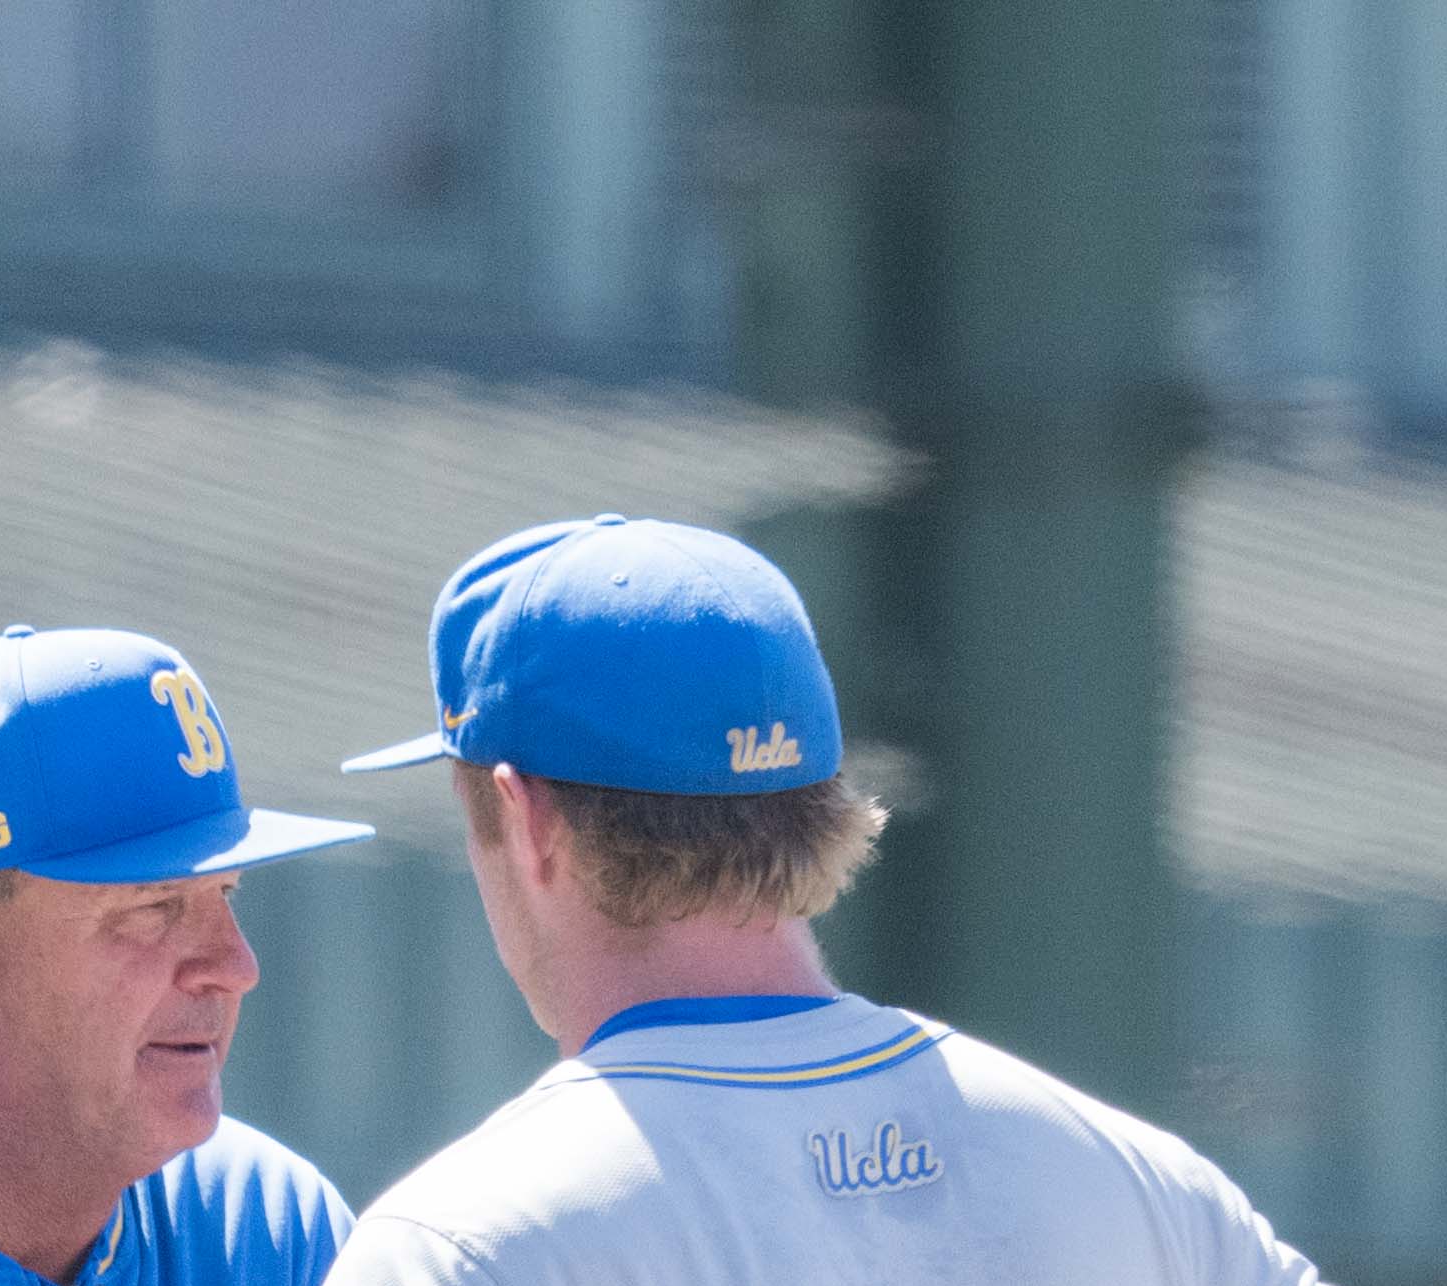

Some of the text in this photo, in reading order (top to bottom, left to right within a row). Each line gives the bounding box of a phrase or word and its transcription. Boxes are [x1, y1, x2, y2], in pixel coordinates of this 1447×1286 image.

[150, 667, 226, 777] B
[726, 721, 802, 774] Ucla
[810, 1120, 942, 1196] Ucla
